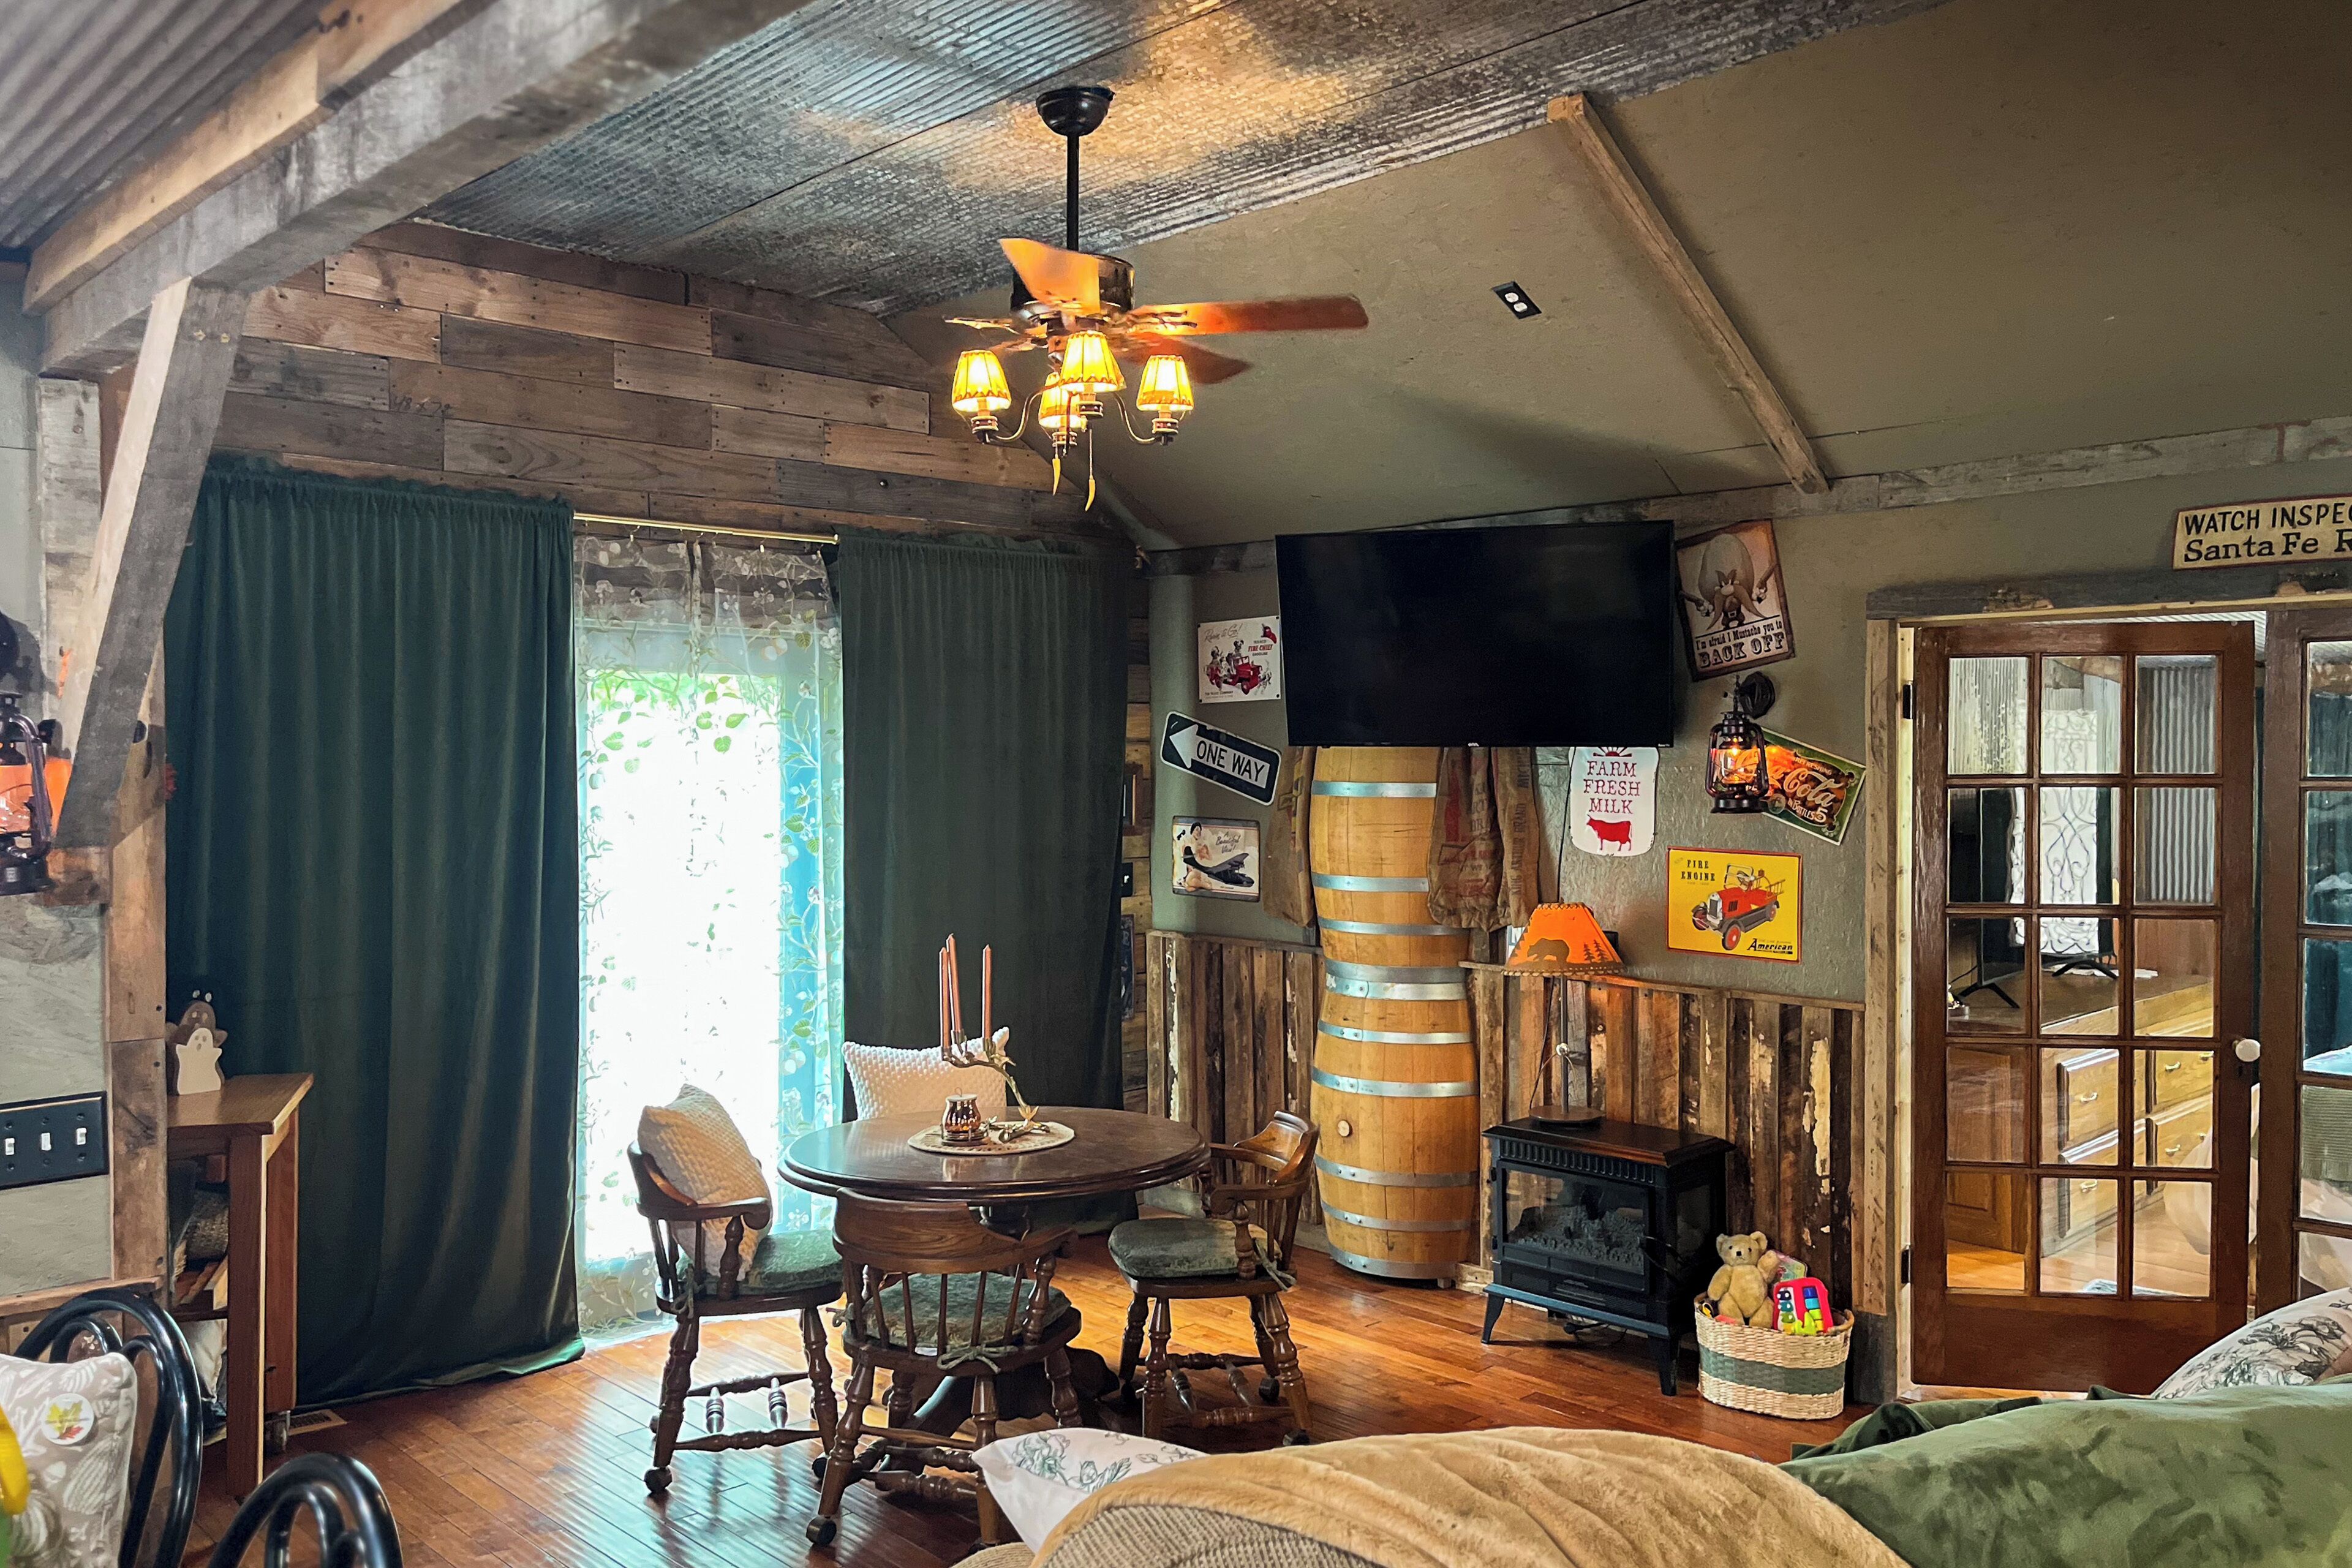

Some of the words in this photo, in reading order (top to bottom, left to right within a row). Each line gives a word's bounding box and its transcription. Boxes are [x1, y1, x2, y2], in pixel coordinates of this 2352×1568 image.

[2185, 508, 2260, 536] WATCH
[2184, 535, 2275, 563] Santa
[2282, 532, 2319, 556] Fe
[1708, 633, 1726, 647] afraid
[1727, 632, 1731, 643] I
[1733, 625, 1762, 641] Mustache
[1763, 622, 1774, 635] you
[1776, 620, 1783, 630] to
[1698, 641, 1747, 668] BACK
[1751, 631, 1785, 655] OFF
[1196, 740, 1228, 769] ONE
[1232, 753, 1265, 783] WAY
[1587, 760, 1637, 777] FARM
[1583, 778, 1641, 796] FRESH
[1588, 797, 1634, 815] MILK
[1687, 859, 1709, 869] FIRE
[1681, 871, 1715, 881] ENGINE
[1747, 938, 1793, 951] American
